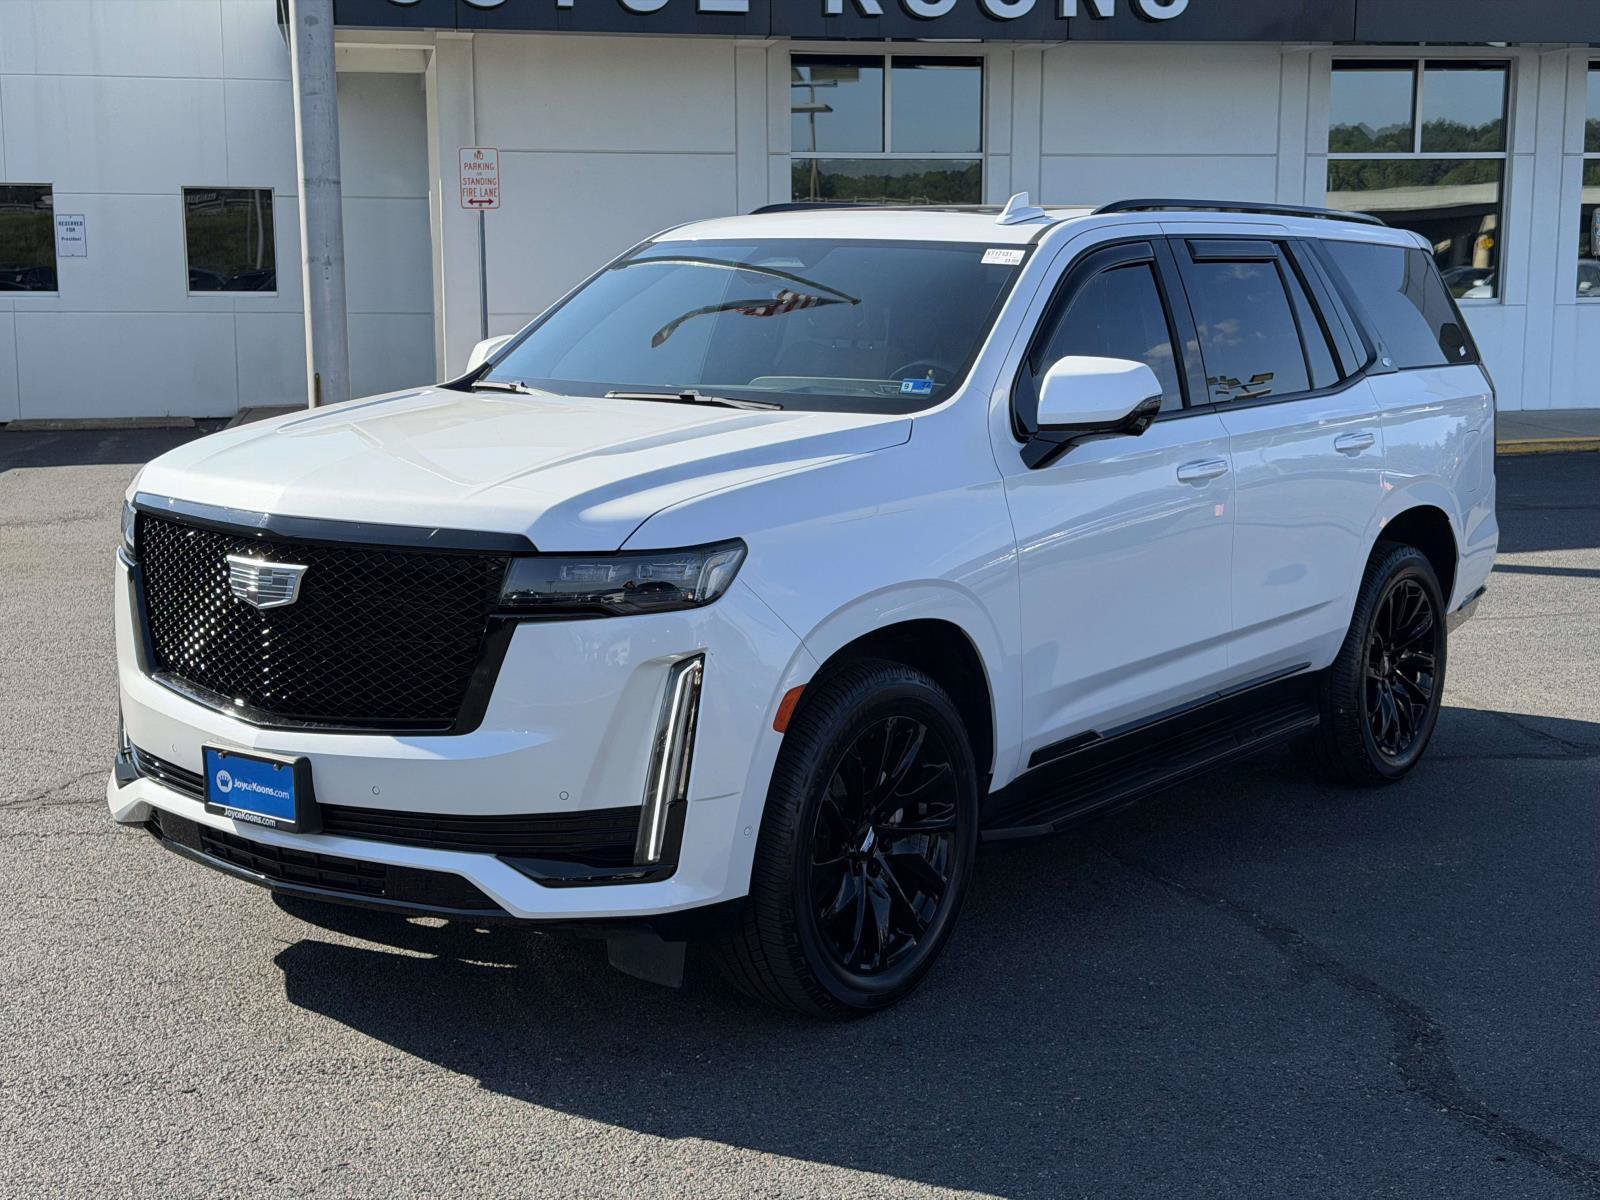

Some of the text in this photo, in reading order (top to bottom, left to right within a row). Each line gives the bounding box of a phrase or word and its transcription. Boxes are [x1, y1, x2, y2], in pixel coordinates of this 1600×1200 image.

[474, 151, 484, 160] NO
[464, 162, 495, 170] PARKING
[463, 178, 497, 186] STANDING
[463, 188, 497, 197] FIRE LANE
[234, 778, 290, 800] JoyceKoons.com
[224, 807, 276, 828] JoyceKoons.com
